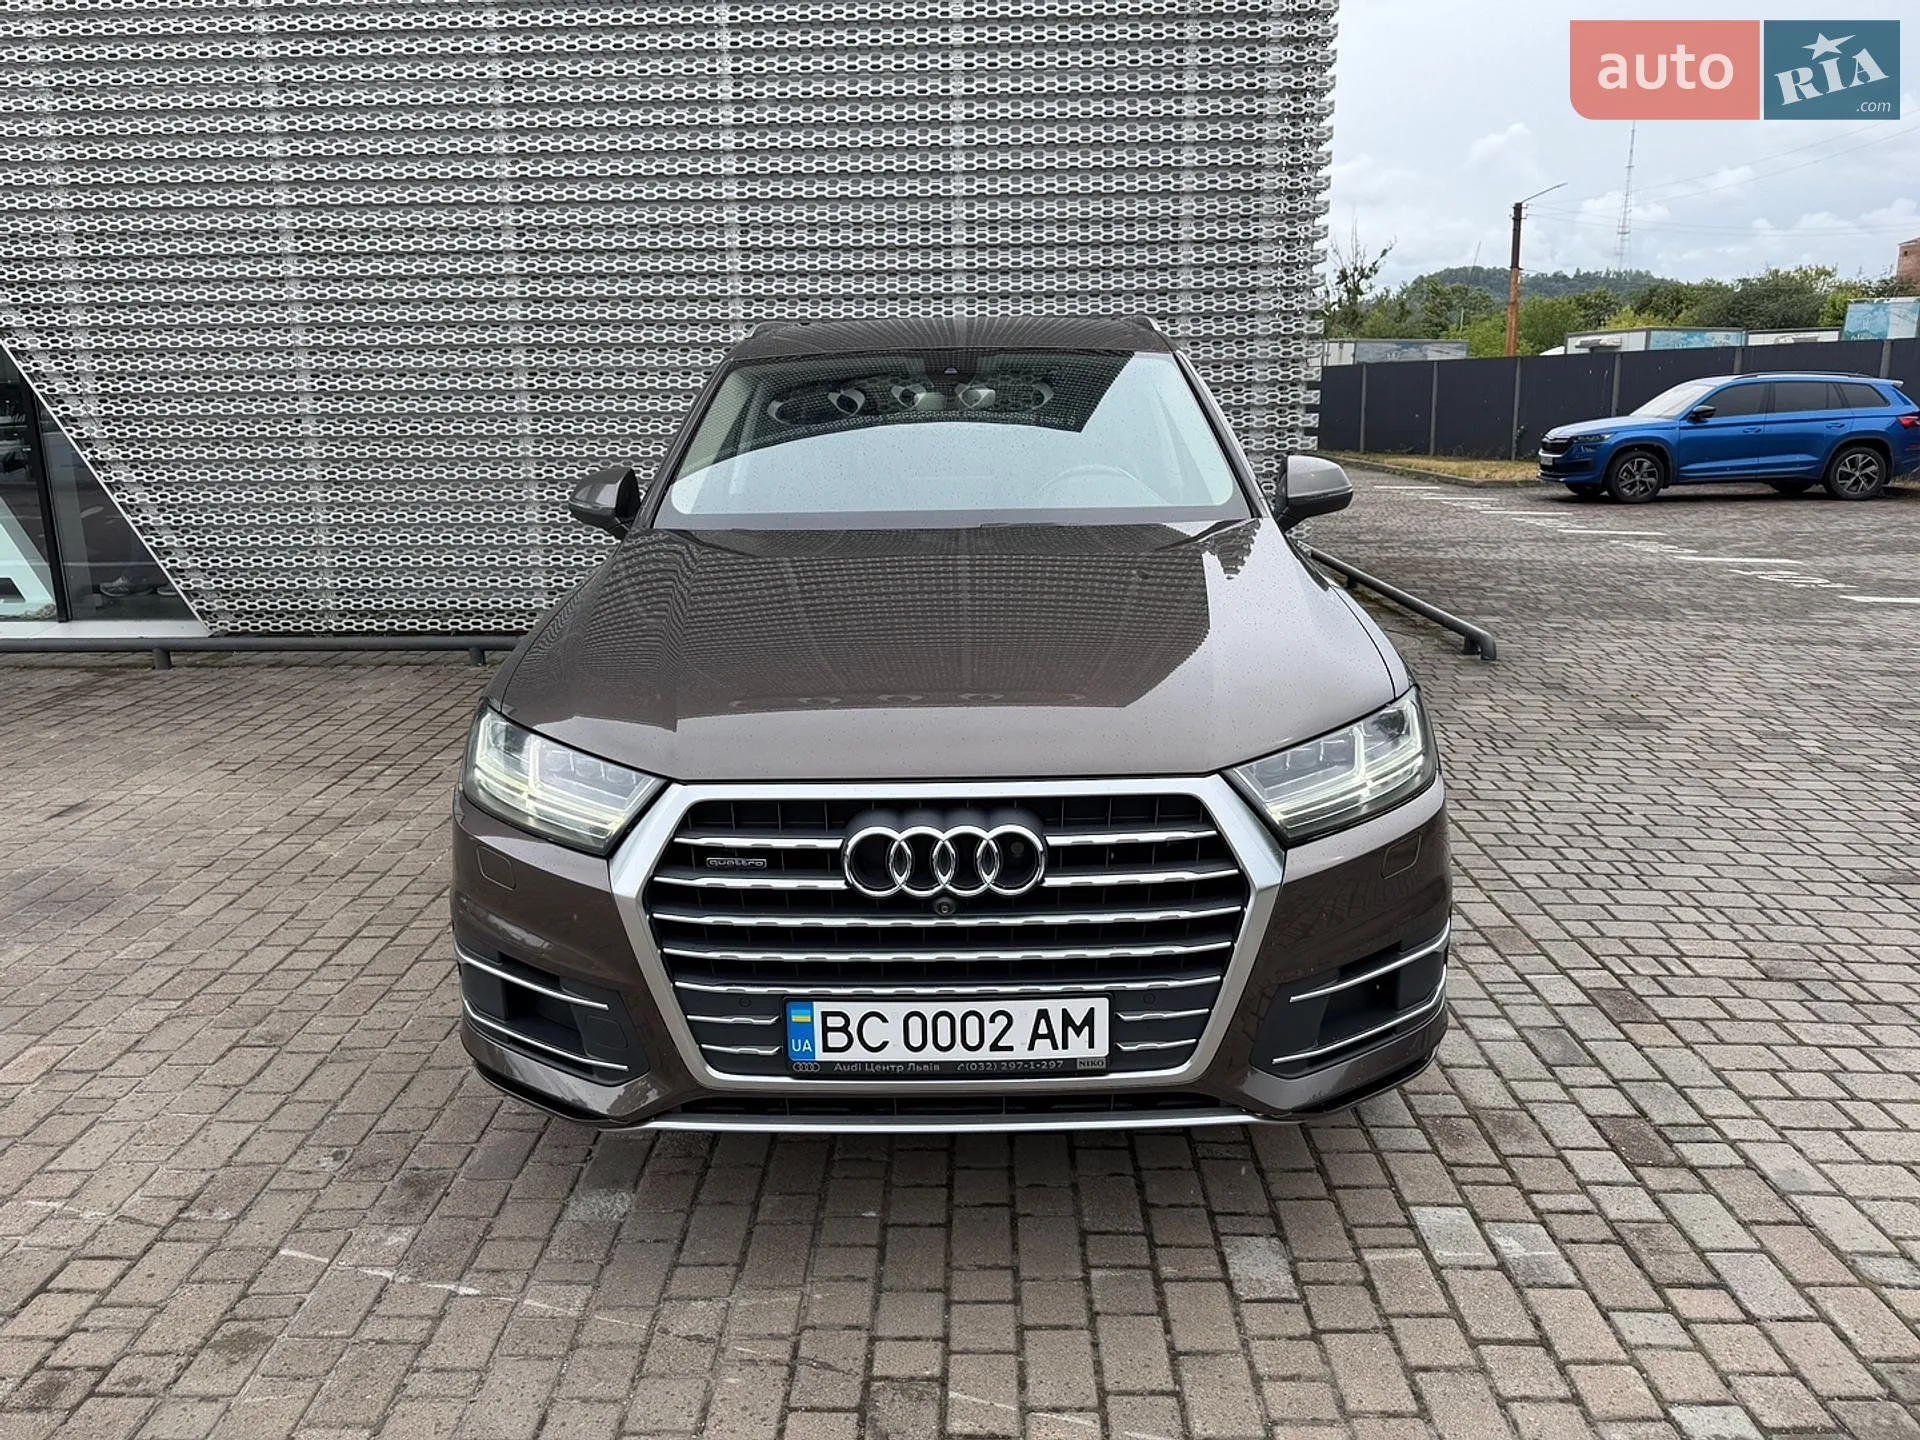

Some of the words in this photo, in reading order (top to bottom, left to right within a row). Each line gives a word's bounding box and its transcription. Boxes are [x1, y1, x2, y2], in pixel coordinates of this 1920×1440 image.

[820, 1010, 890, 1053] BC
[902, 1009, 1014, 1052] 0002
[1027, 1007, 1095, 1051] AM
[791, 1038, 813, 1052] UA
[833, 1062, 862, 1072] Audi
[865, 1062, 904, 1073] Центр
[907, 1062, 940, 1072] Львів
[966, 1061, 997, 1071] (032)
